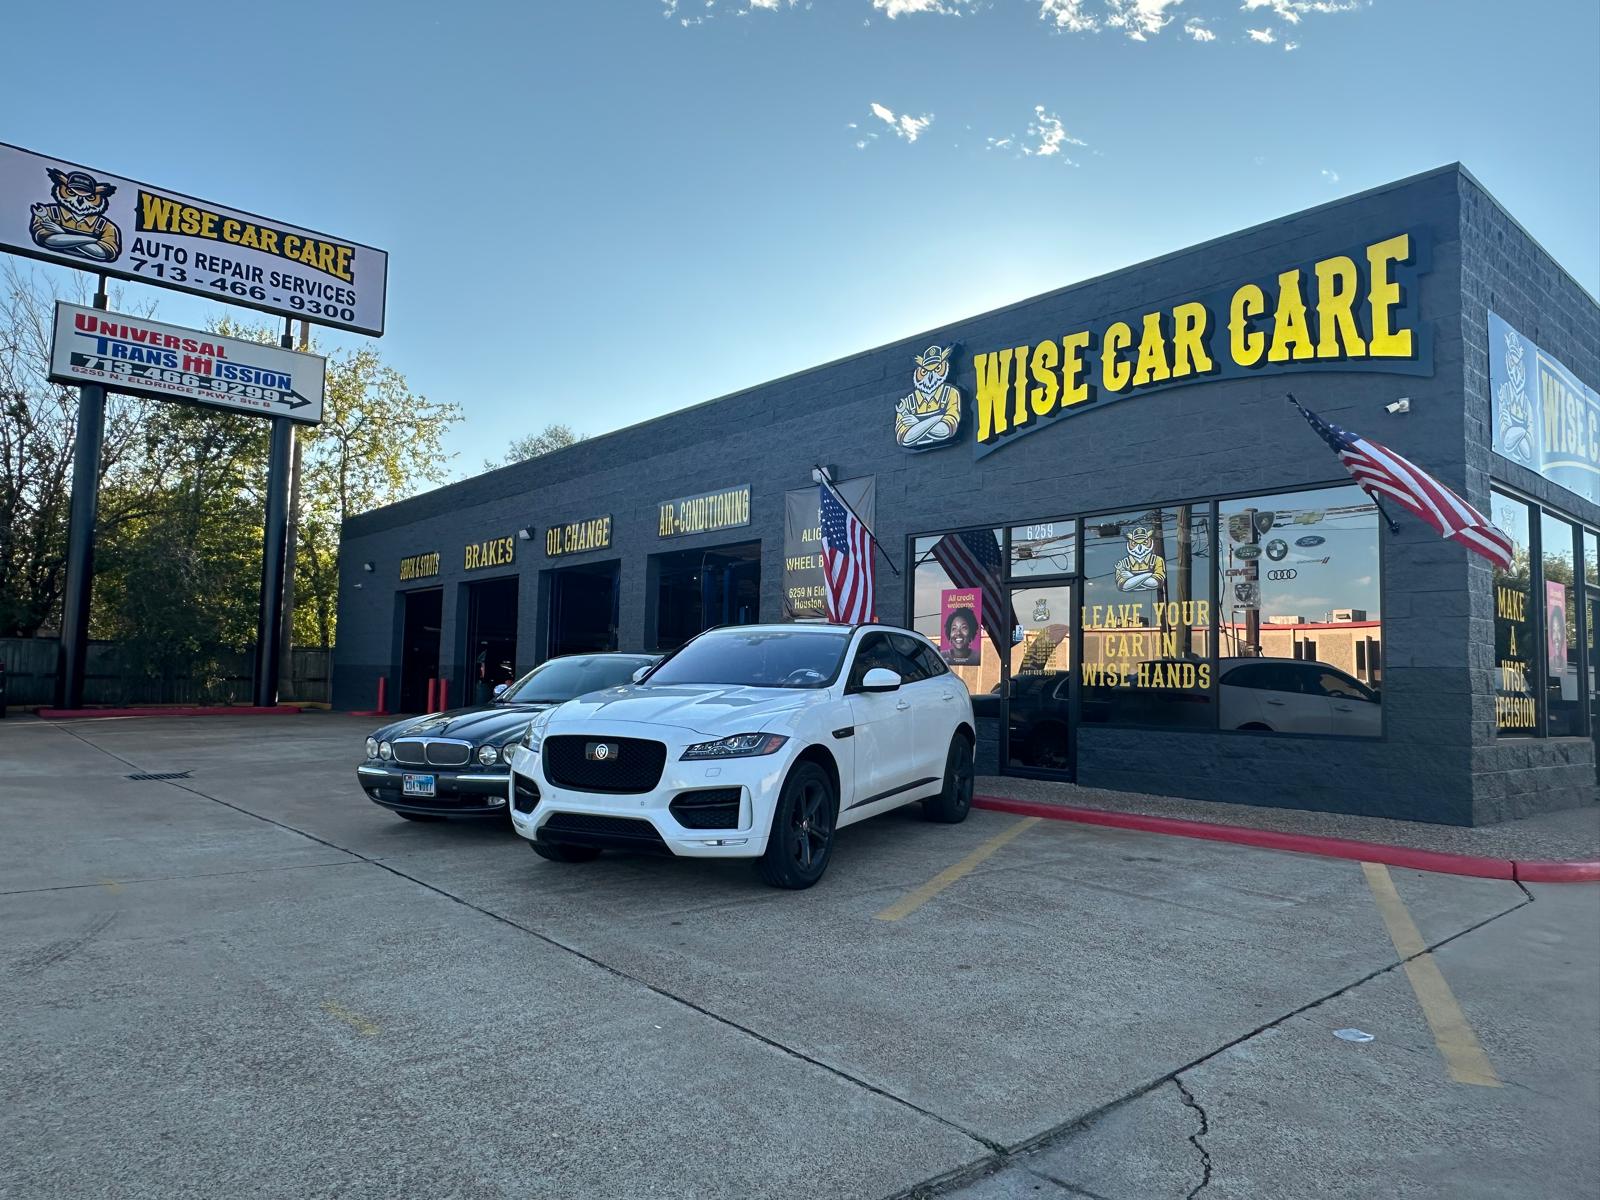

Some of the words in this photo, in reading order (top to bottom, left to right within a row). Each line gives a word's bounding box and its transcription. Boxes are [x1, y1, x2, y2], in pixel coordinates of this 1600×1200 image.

[142, 193, 219, 239] WISE
[223, 219, 279, 254] CAR
[284, 234, 352, 281] CARE
[131, 237, 188, 265] AUTO
[194, 251, 263, 284] REPAIR
[269, 271, 356, 306] SERVICES
[75, 313, 228, 360] UNIVERSAL
[973, 330, 1090, 443] WISE
[1100, 301, 1212, 392] CAR
[1227, 233, 1412, 367] CARE
[82, 355, 280, 401] 713-466-9299
[127, 376, 193, 394] ELDRIDGE
[1541, 368, 1586, 459] WISE
[1587, 410, 1600, 463] C
[658, 489, 749, 537] AIR-CONDITIONING
[546, 530, 562, 556] OIL
[564, 517, 610, 553] CHANGE
[801, 527, 822, 542] ALIG
[1026, 523, 1054, 541] 6259
[464, 539, 514, 570] BRAKES
[786, 555, 816, 570] WHEEL
[788, 587, 805, 599] 6259
[807, 586, 812, 598] N
[957, 593, 975, 602] credit
[1497, 586, 1526, 622] MAKE
[1081, 603, 1144, 629] LEAVE
[1152, 599, 1210, 627] YOUR
[1105, 633, 1145, 658] CAR
[1154, 632, 1177, 658] IN
[1510, 626, 1517, 656] A
[1081, 663, 1131, 687] WISE
[1136, 663, 1211, 689] HANDS
[1501, 660, 1526, 692] WISE
